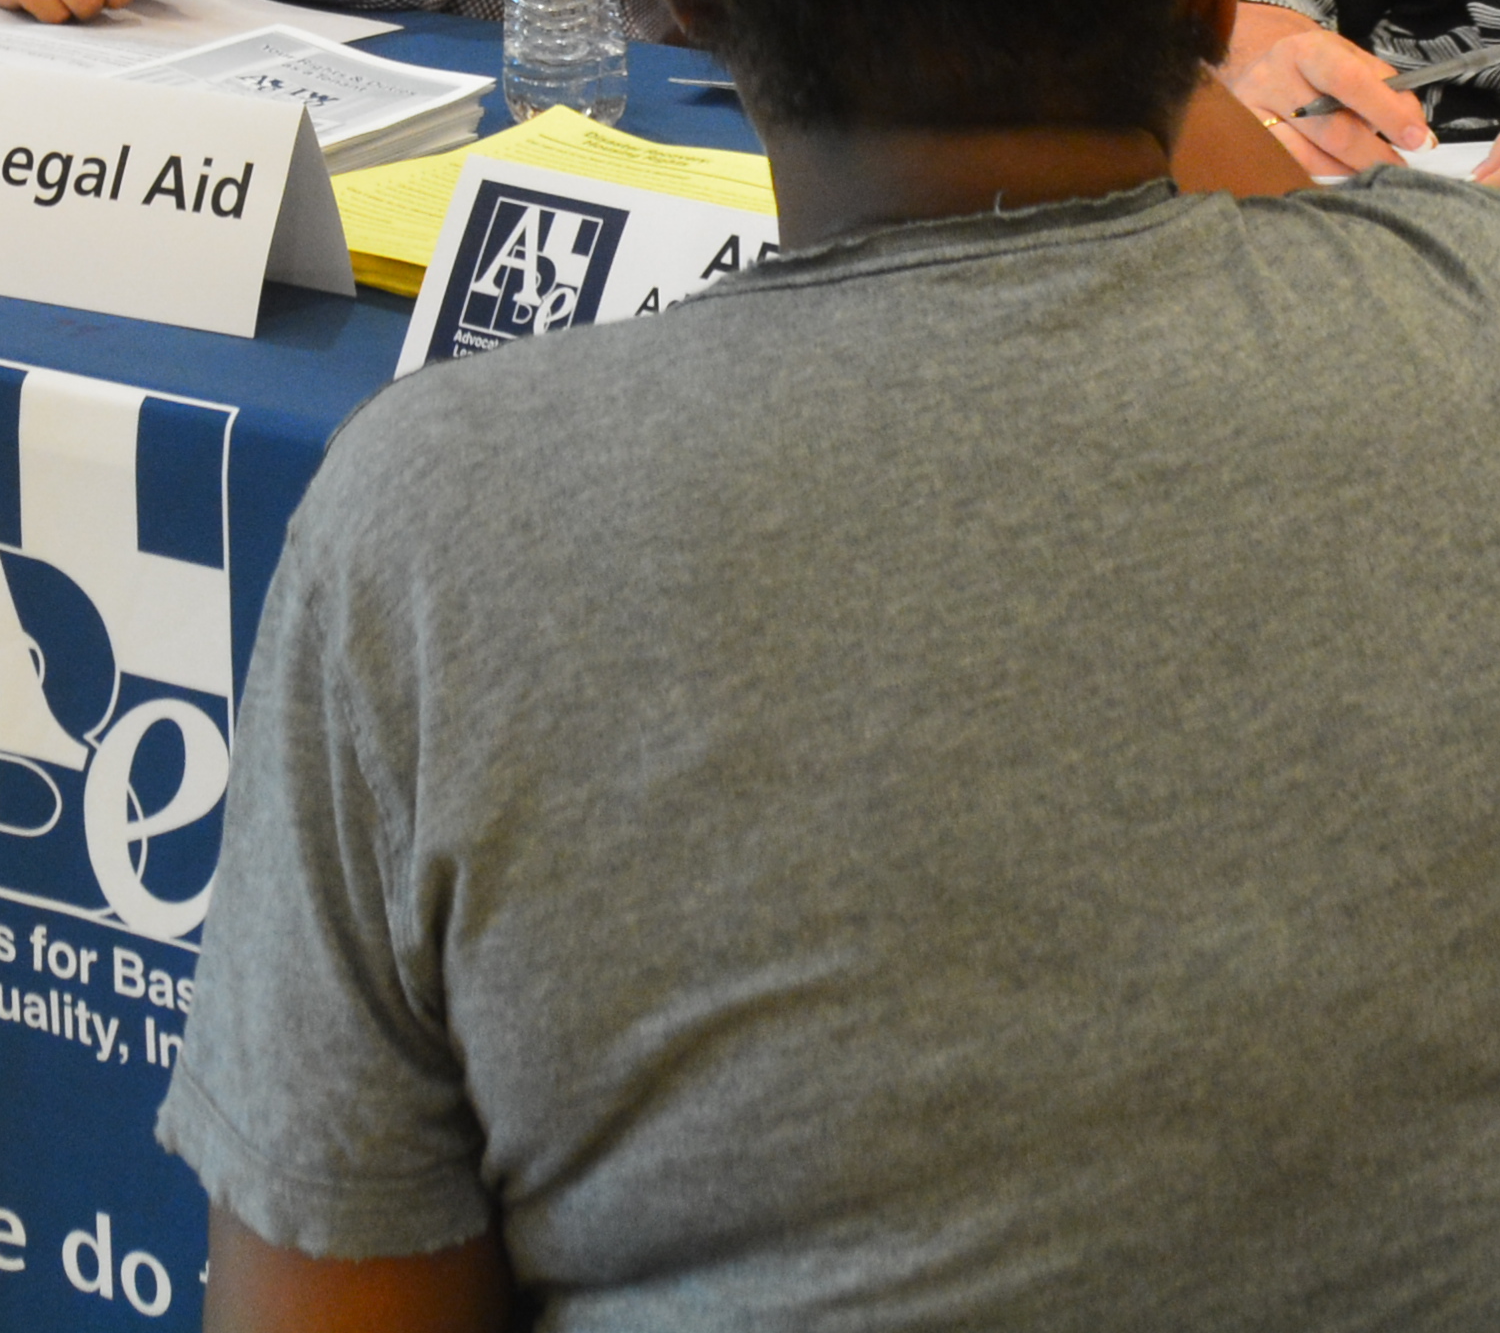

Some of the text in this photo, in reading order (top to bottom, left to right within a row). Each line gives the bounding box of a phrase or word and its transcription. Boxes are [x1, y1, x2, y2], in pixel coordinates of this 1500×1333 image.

[141, 154, 254, 220] Aid
[453, 329, 499, 350] Advocat
[30, 925, 97, 984] for
[112, 947, 197, 1013] Bas
[145, 1016, 183, 1066] In
[62, 1214, 173, 1318] do
